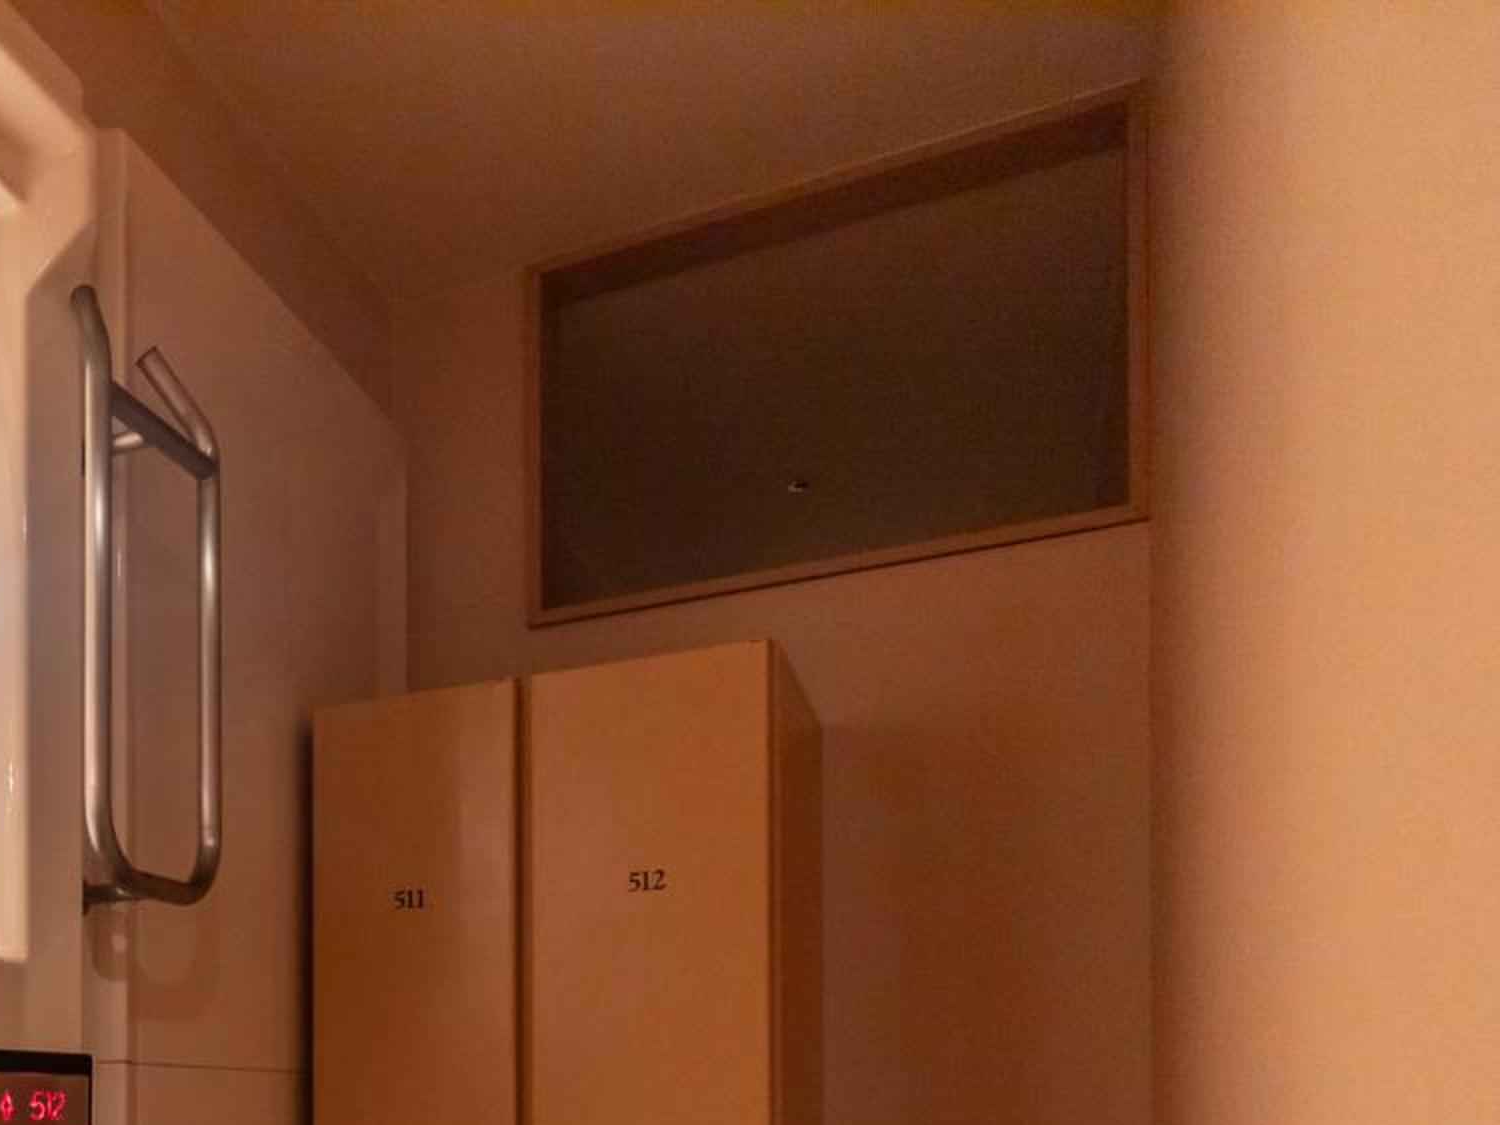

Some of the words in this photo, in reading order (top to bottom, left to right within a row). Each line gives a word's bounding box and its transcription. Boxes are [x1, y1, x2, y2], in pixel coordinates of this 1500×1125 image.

[628, 869, 667, 892] 512
[393, 889, 424, 909] 511
[31, 1090, 67, 1121] 512
